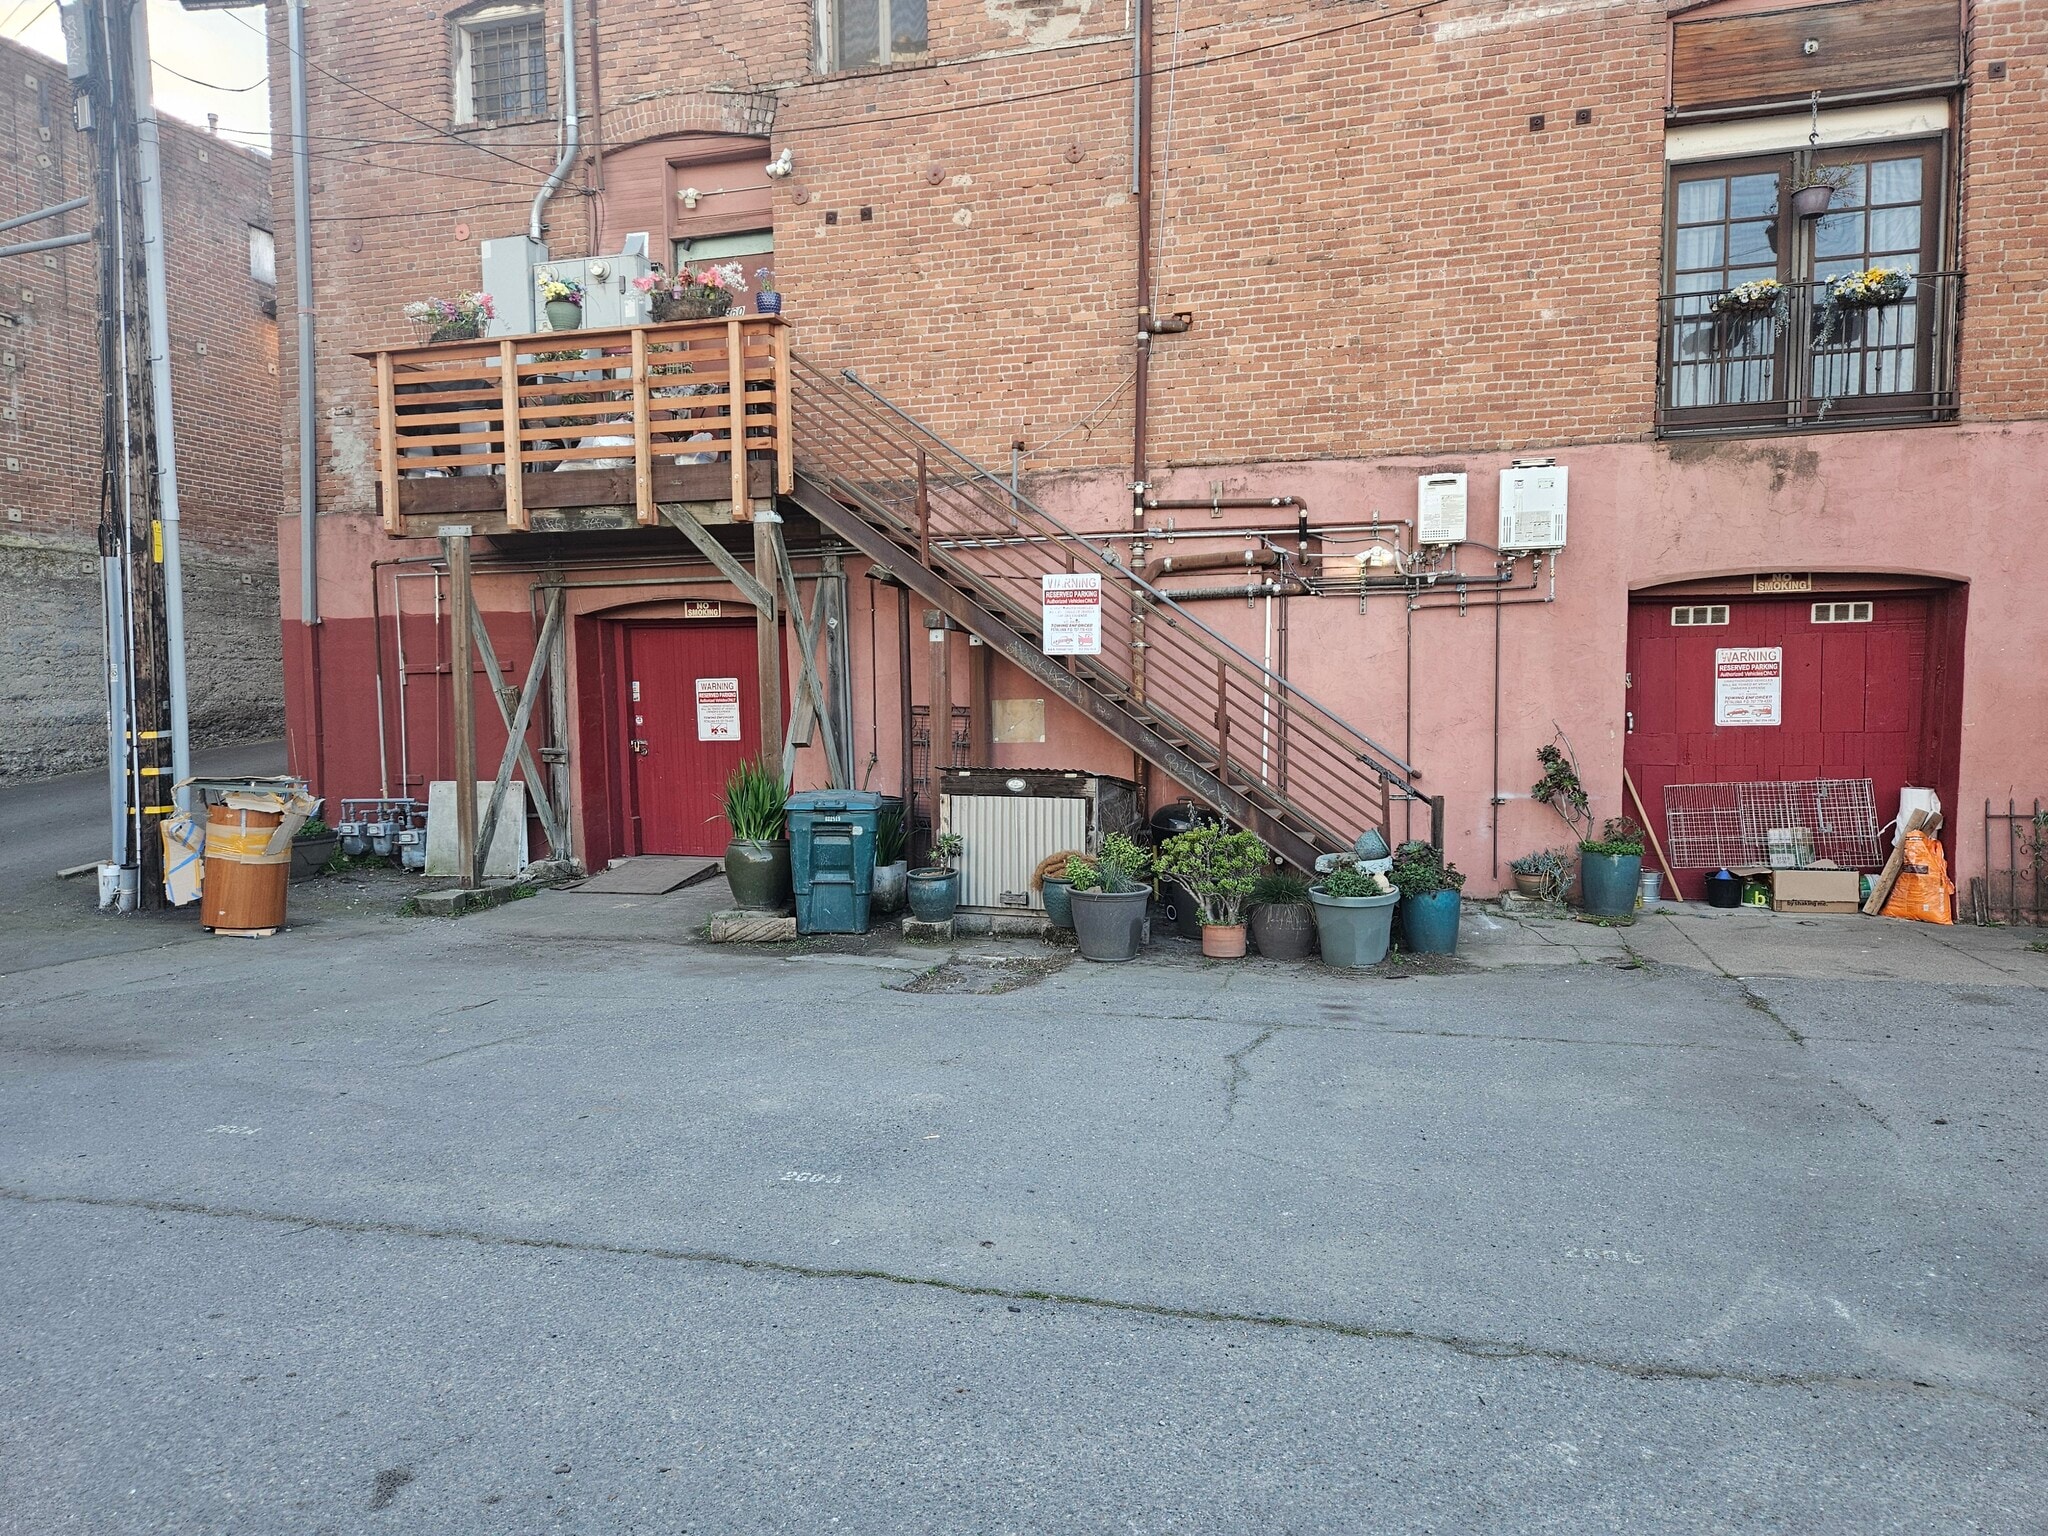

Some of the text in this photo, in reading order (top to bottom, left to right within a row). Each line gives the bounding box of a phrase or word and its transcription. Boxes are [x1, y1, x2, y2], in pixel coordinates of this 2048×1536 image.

[1772, 573, 1793, 582] NO
[1757, 581, 1807, 590] SMOKING
[1721, 651, 1777, 662] WARNING
[700, 682, 734, 690] WARNING
